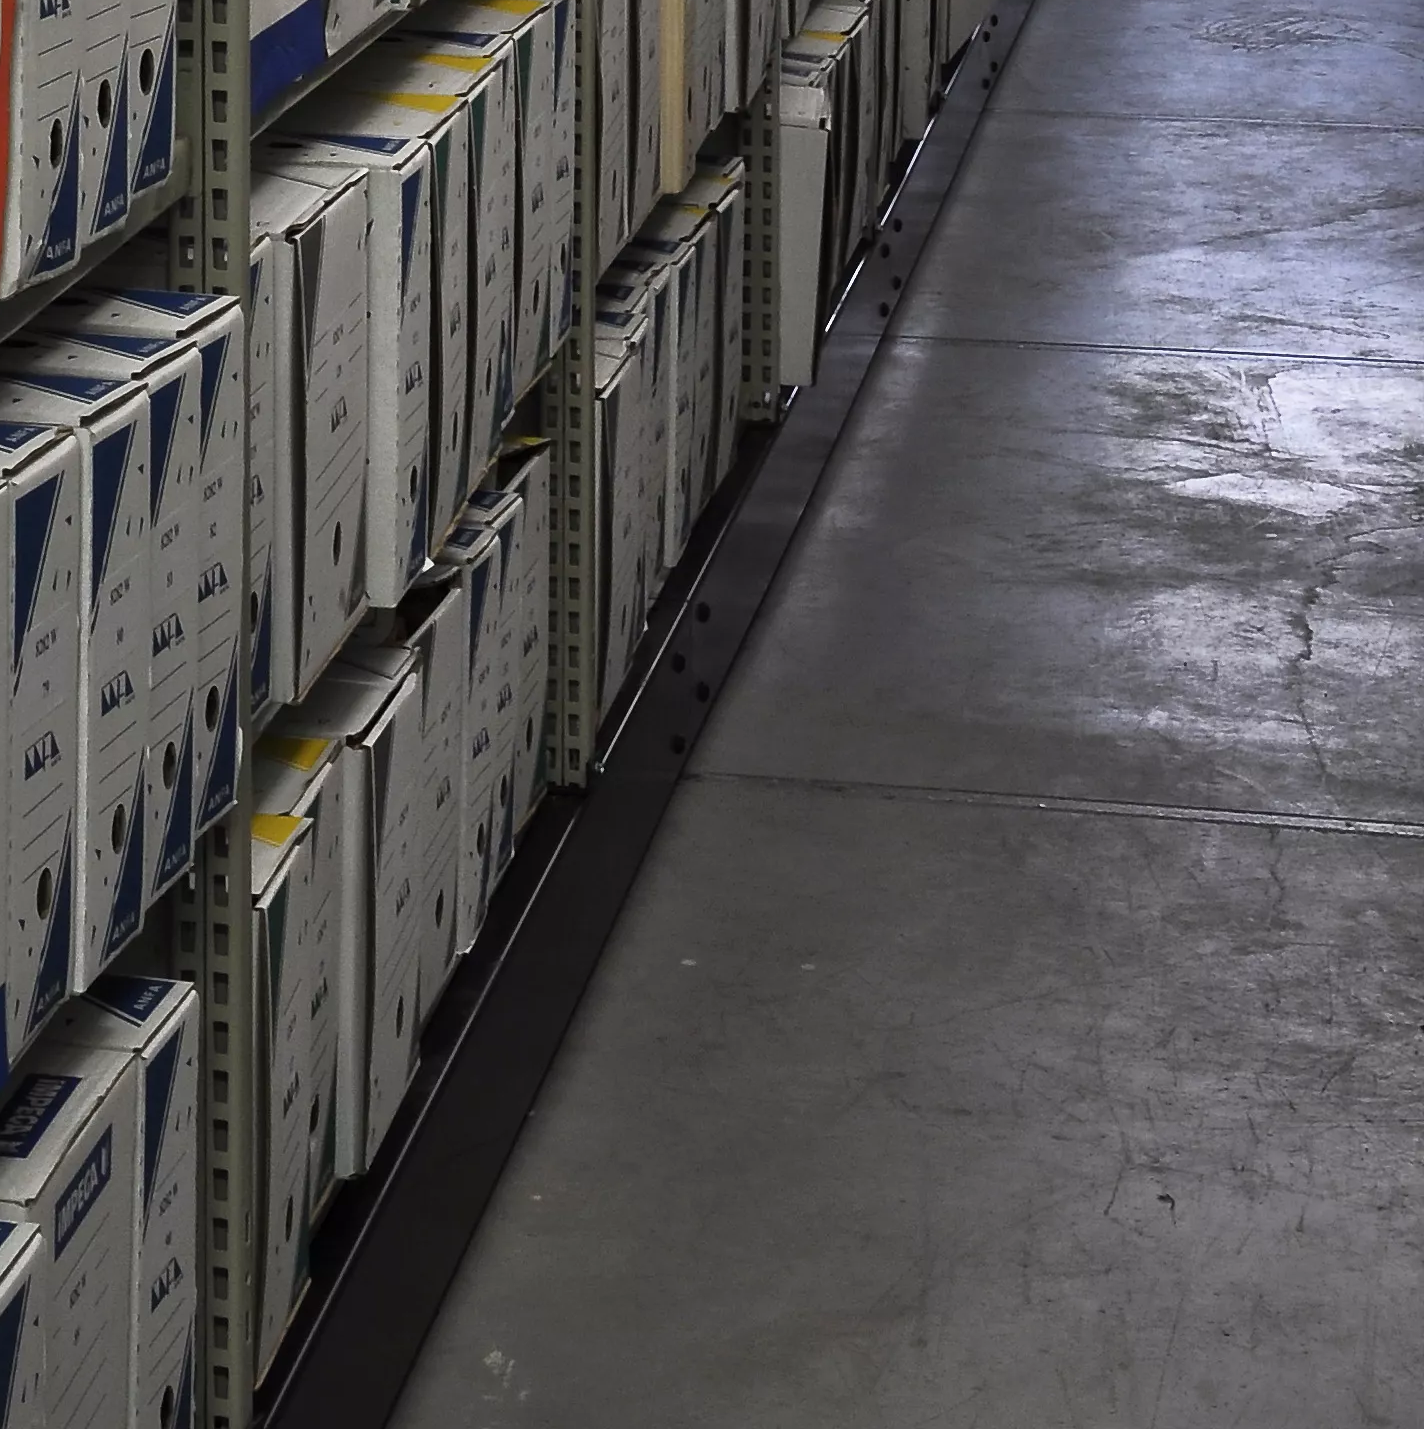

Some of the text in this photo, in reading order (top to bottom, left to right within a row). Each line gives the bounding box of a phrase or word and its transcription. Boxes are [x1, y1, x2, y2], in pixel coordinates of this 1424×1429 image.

[143, 157, 166, 178] ANFA
[104, 199, 124, 217] ANFA
[46, 238, 71, 260] ANFA
[133, 982, 164, 1011] ANFA
